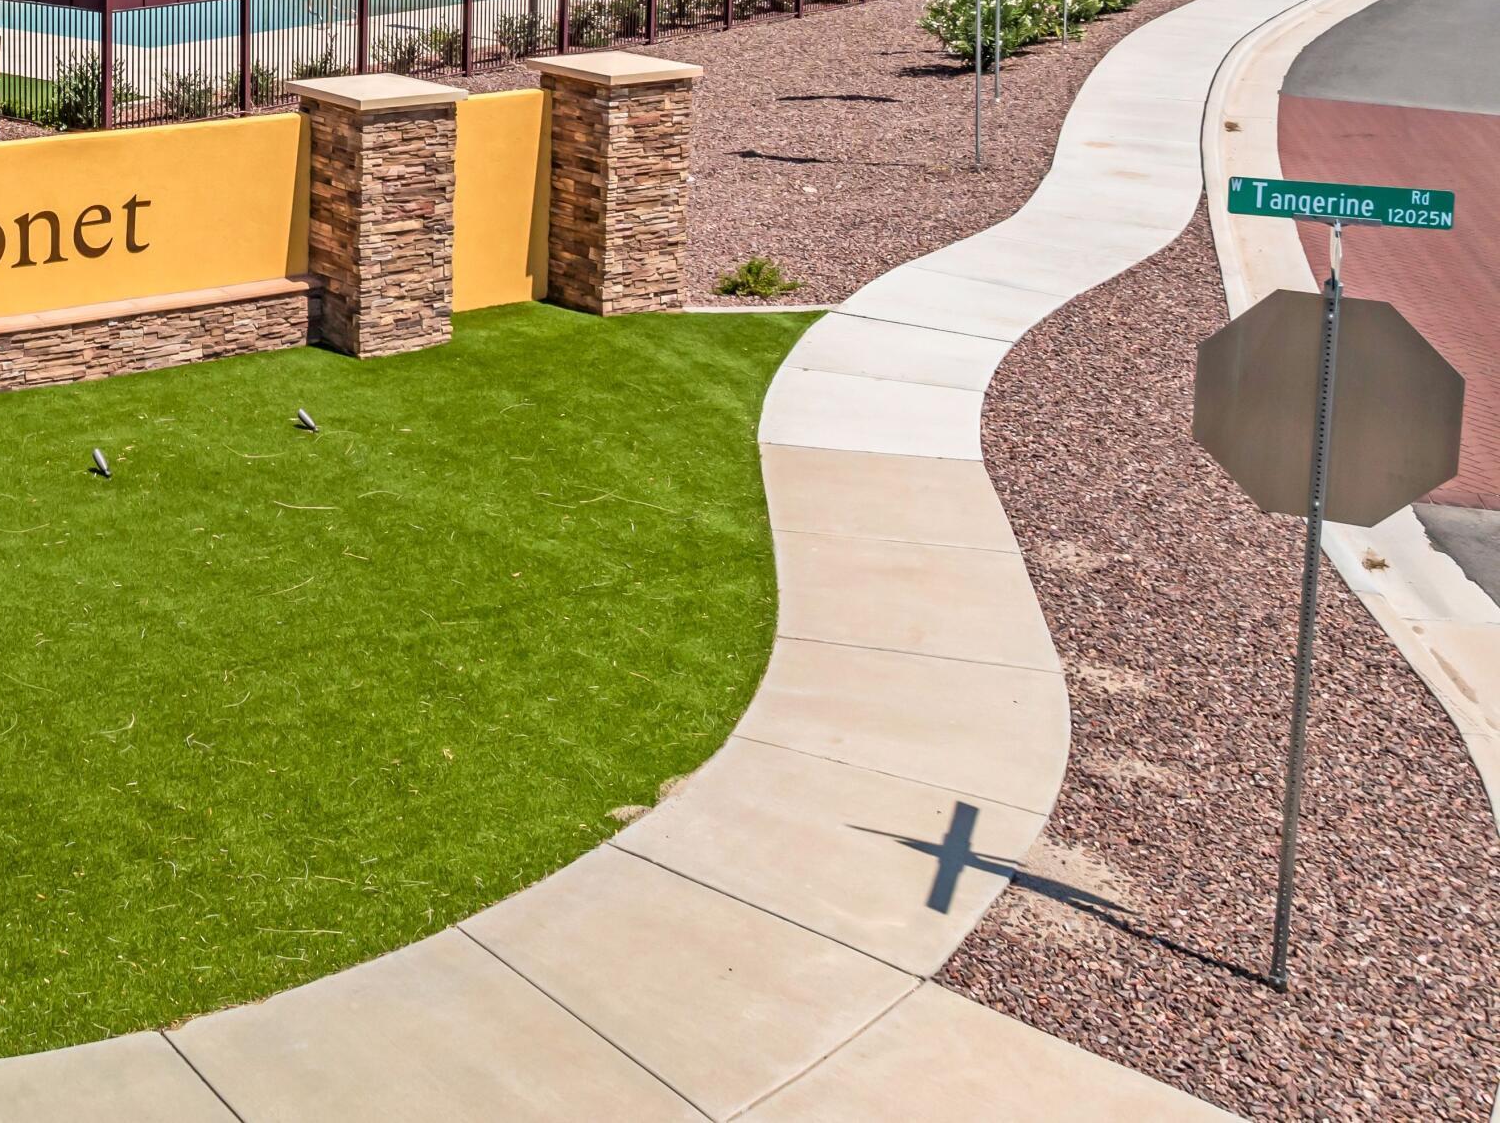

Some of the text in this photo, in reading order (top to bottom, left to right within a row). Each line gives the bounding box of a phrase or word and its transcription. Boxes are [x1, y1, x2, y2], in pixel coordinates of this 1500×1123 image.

[1231, 178, 1430, 217] W Tangerine Rd
[1388, 208, 1452, 226] 12025N
